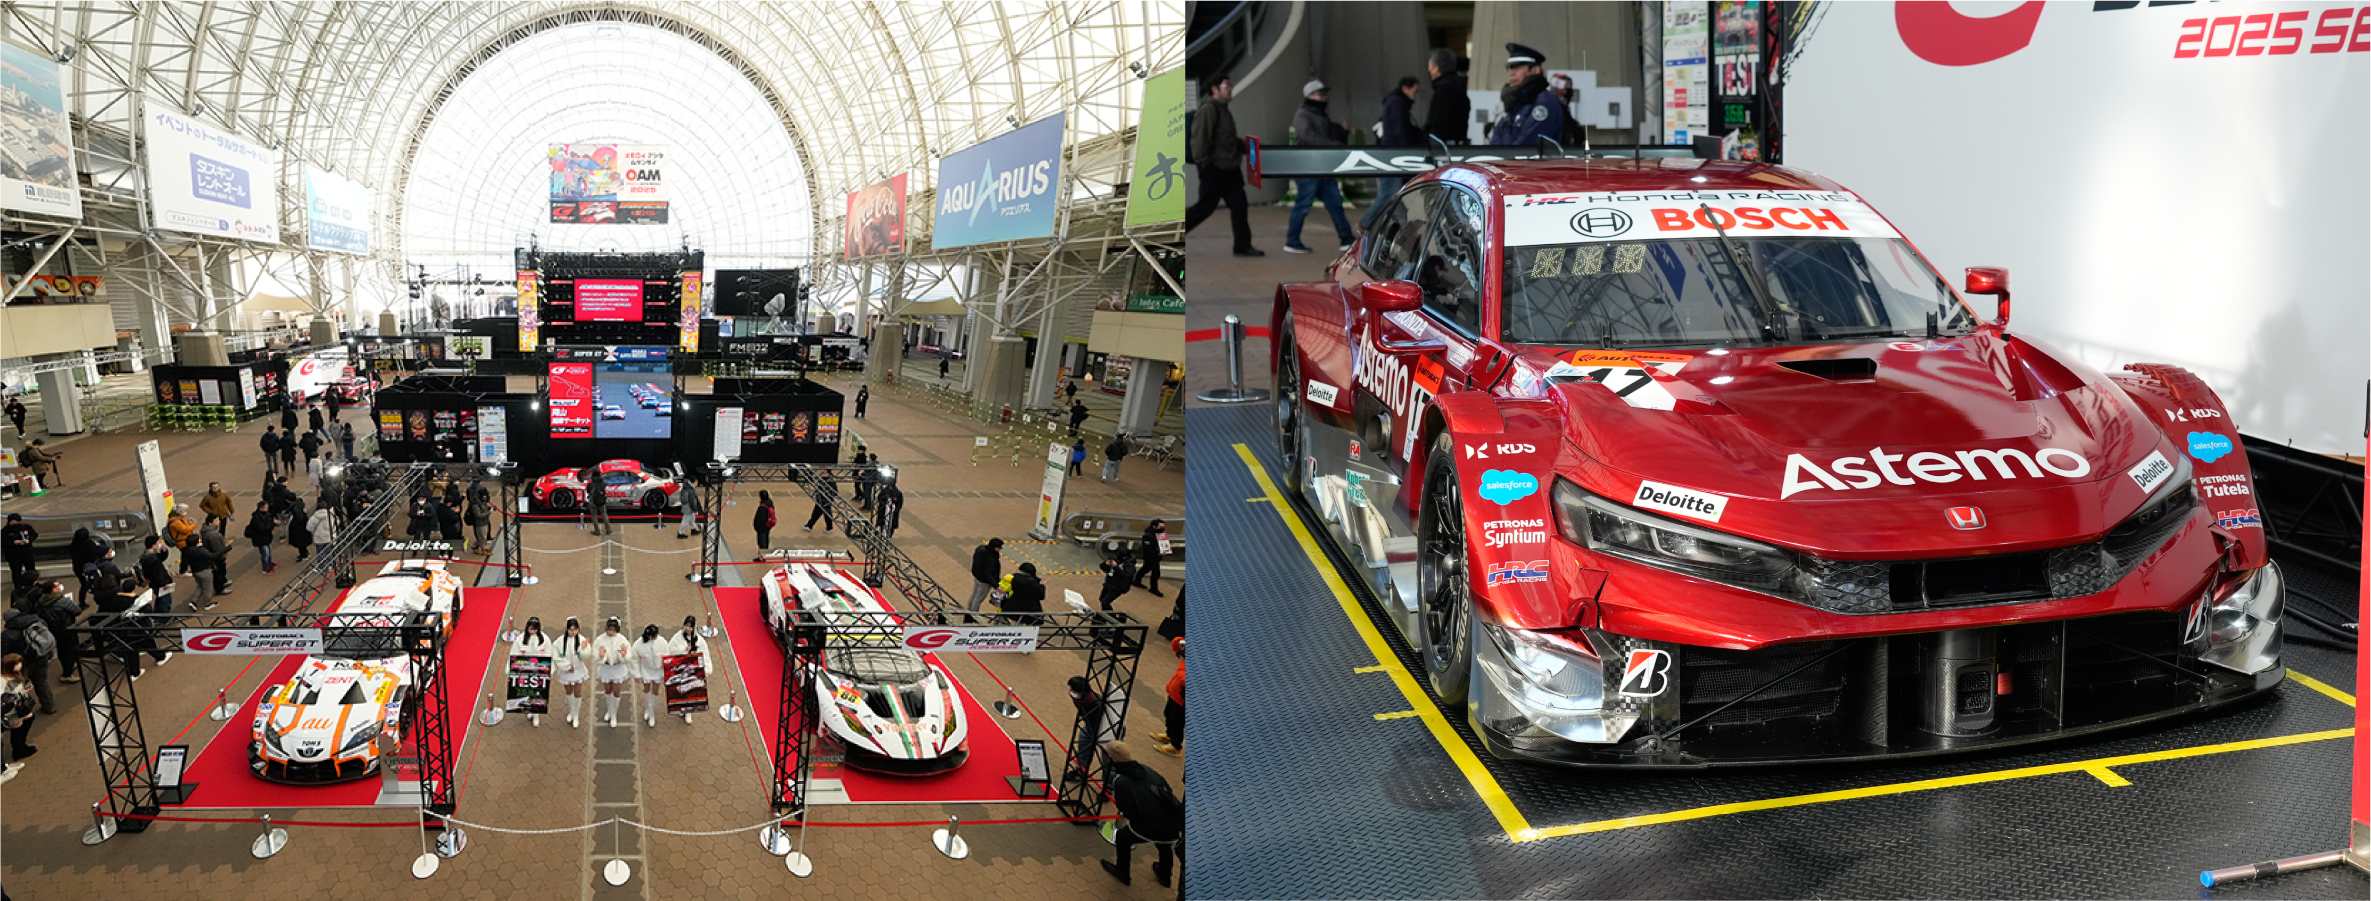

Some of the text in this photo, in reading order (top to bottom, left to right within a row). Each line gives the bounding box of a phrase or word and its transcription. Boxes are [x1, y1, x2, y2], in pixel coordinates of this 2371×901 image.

[2174, 10, 2310, 59] 2025
[1714, 53, 1760, 97] TEST
[625, 168, 661, 181] OAM
[196, 173, 247, 198] レントオール
[941, 158, 1052, 228] AQUARIUS
[1522, 191, 1850, 207] HRC Honda RACING
[1651, 207, 1850, 232] BOSCH
[1139, 298, 1184, 307] Intex Cafe
[1394, 311, 1429, 337] HONDA
[1596, 352, 1685, 362] AUTOBACS
[1352, 323, 1409, 417] Astemo
[1421, 367, 1441, 385] AUTOBACS
[1308, 384, 1334, 402] Deloitte.
[2190, 408, 2221, 418] RDS
[1496, 443, 1536, 455] RDS
[2193, 441, 2229, 450] salesforce
[1780, 446, 2092, 500] Astemo
[2134, 458, 2170, 488] Deloitte.
[2200, 474, 2246, 484] PETRONAS
[1486, 480, 1533, 490] salesforce
[2203, 483, 2250, 498] Tutela
[1638, 486, 1719, 516] Deloitte.
[1483, 519, 1544, 530] PETRONAS
[2217, 509, 2262, 527] HRC
[1485, 528, 1546, 549] Syntium
[1487, 559, 1550, 584] HRC
[1487, 580, 1516, 589] Honda
[236, 640, 319, 648] SUPER GT
[954, 638, 1034, 646] SUPER GT
[324, 676, 356, 685] ZENT
[509, 674, 550, 688] TEST
[301, 717, 334, 731] au
